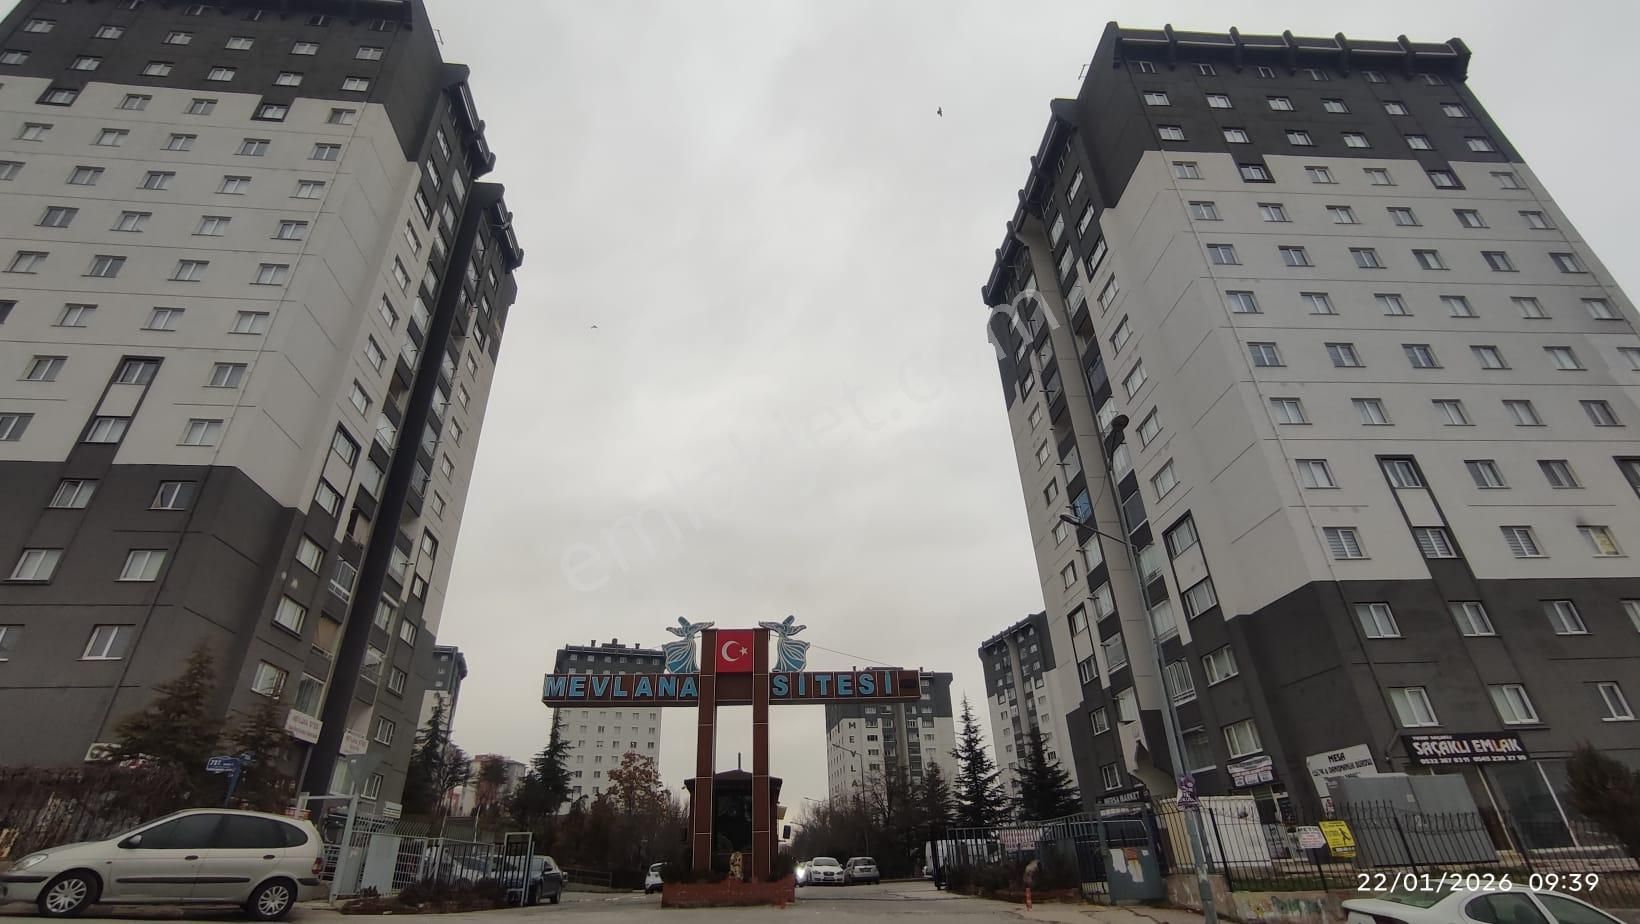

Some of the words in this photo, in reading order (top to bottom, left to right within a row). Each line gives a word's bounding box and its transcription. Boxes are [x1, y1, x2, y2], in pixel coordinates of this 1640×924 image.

[544, 676, 698, 697] MEVLANA
[1412, 739, 1471, 757] SAÇAKLI
[1473, 738, 1523, 753] EMLAK
[1327, 752, 1346, 763] MESA
